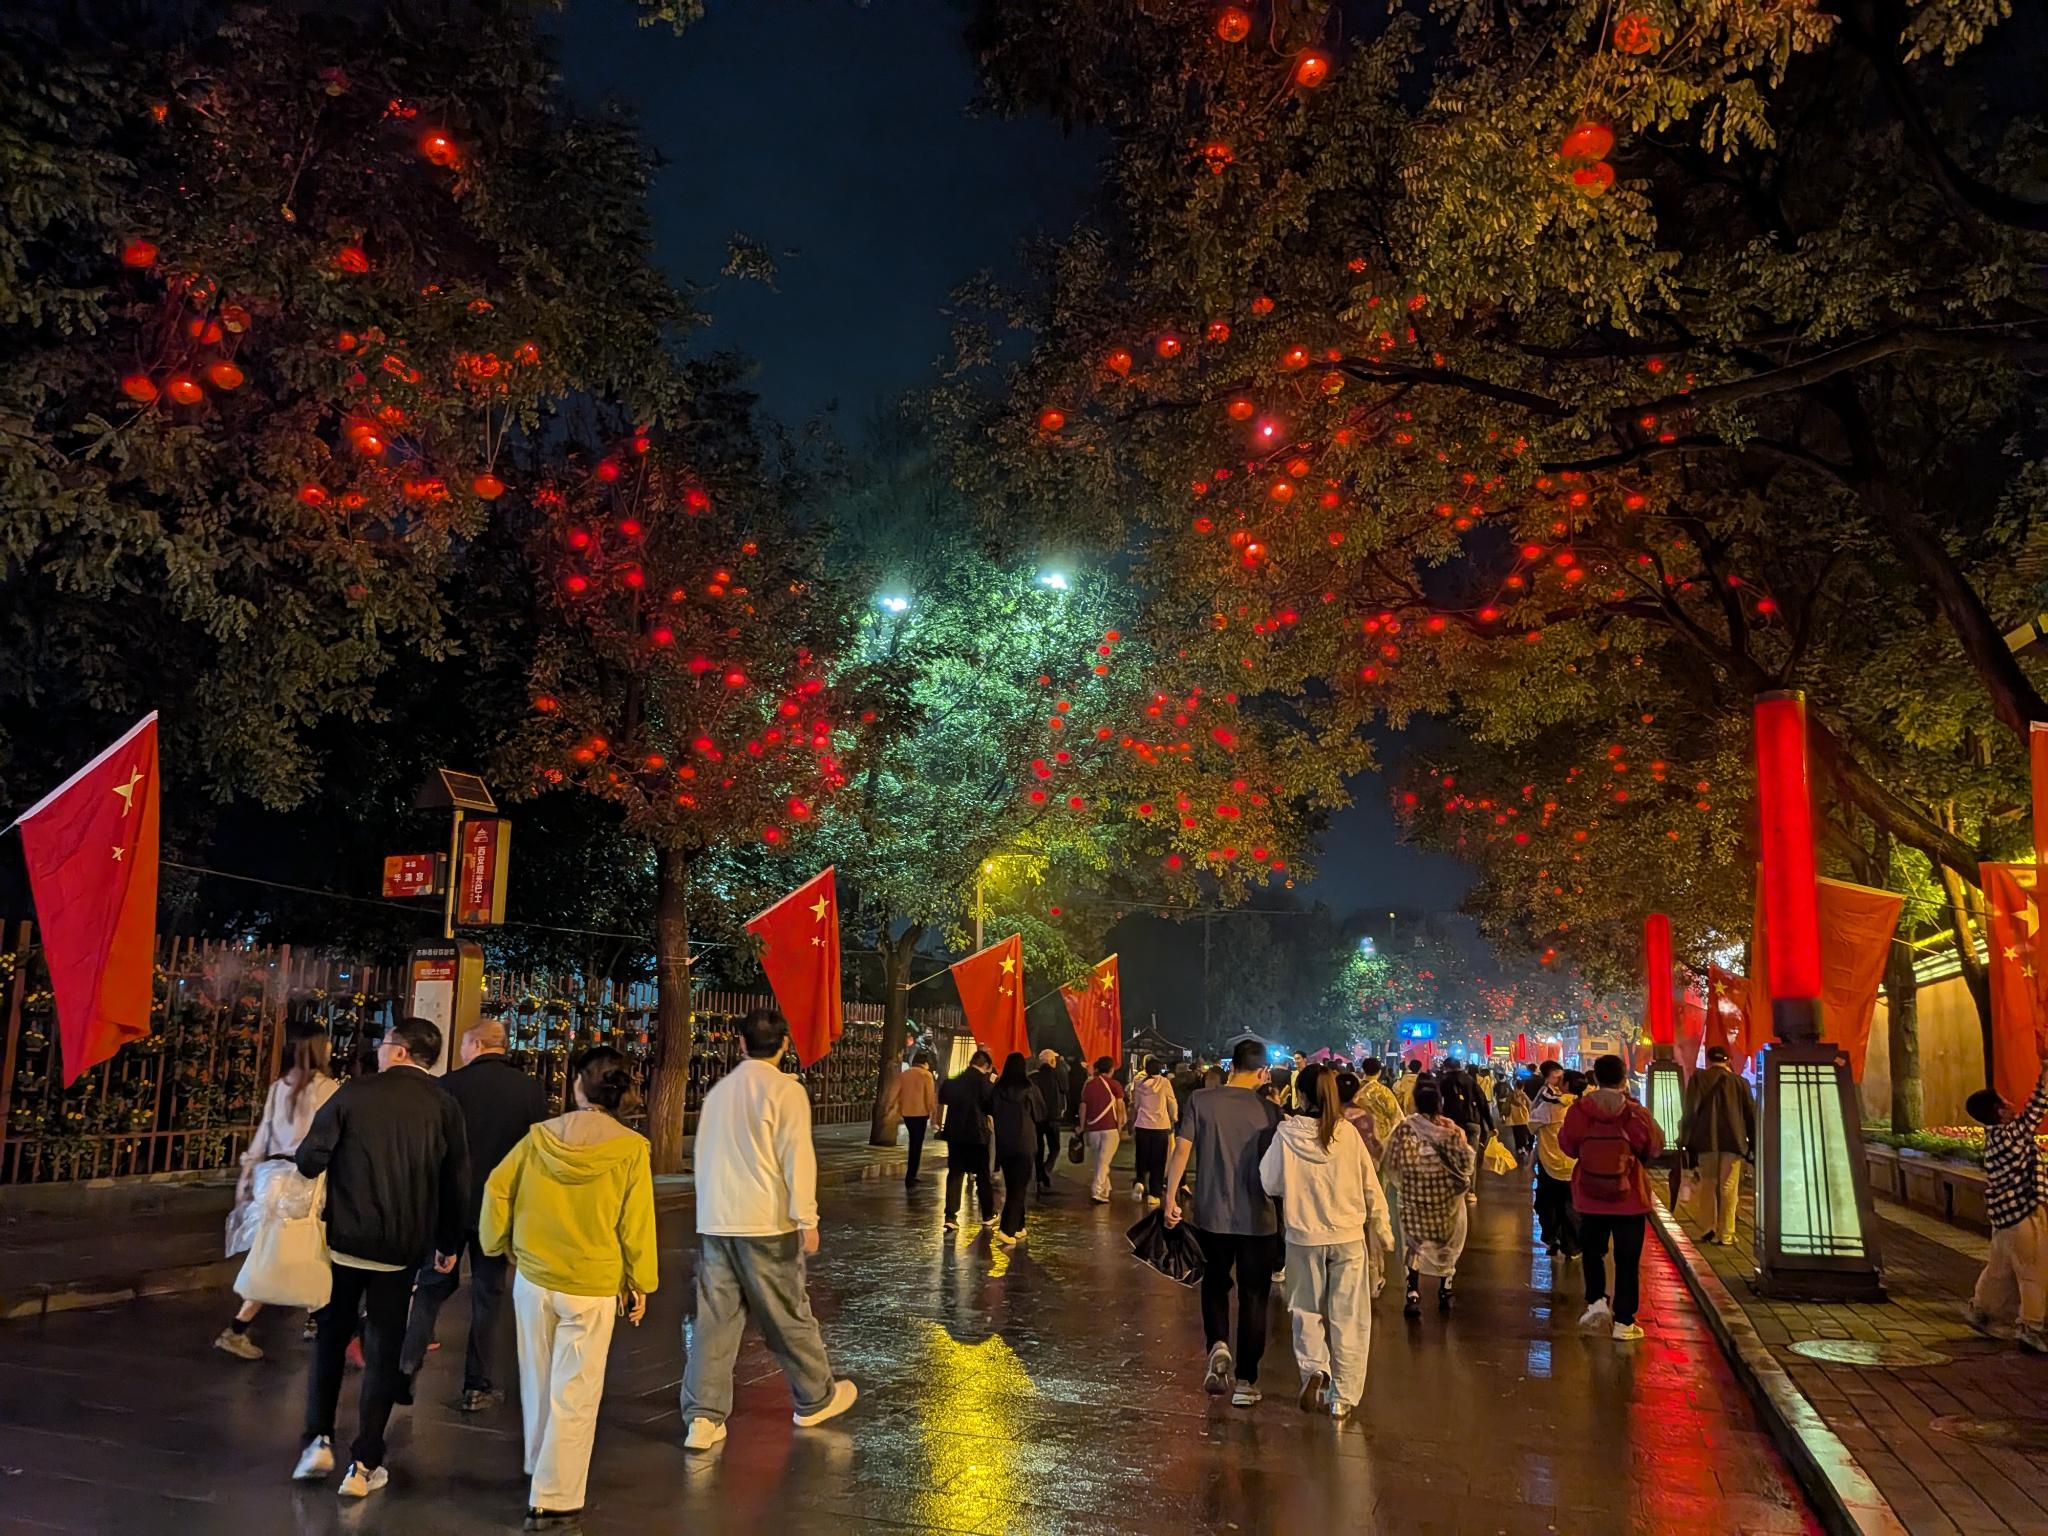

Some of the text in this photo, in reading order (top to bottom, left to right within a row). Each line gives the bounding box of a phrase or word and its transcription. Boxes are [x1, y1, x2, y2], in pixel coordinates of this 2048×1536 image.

[474, 846, 486, 903] 西安观光巴士
